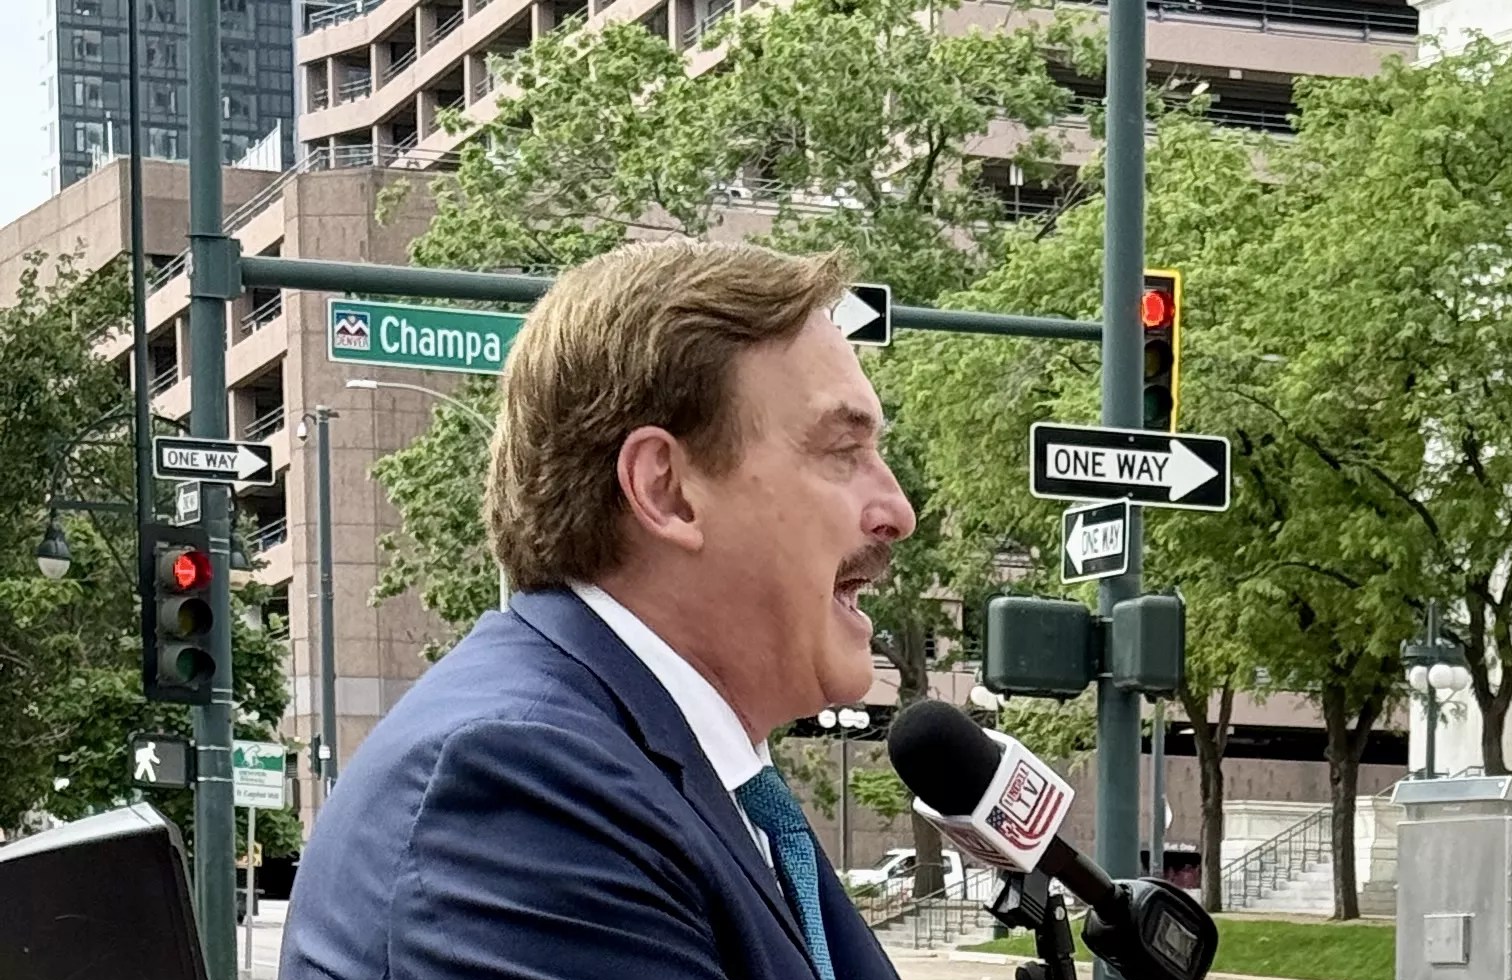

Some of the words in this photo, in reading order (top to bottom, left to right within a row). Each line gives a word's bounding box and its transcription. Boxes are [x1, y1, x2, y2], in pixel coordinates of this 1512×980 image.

[379, 315, 501, 366] Champa
[167, 450, 200, 467] ONE
[205, 452, 238, 470] WAY
[1054, 448, 1106, 478] ONE
[1116, 452, 1169, 482] WAY
[1081, 527, 1099, 556] ONE
[1101, 522, 1121, 551] WAY
[1014, 778, 1038, 809] TV
